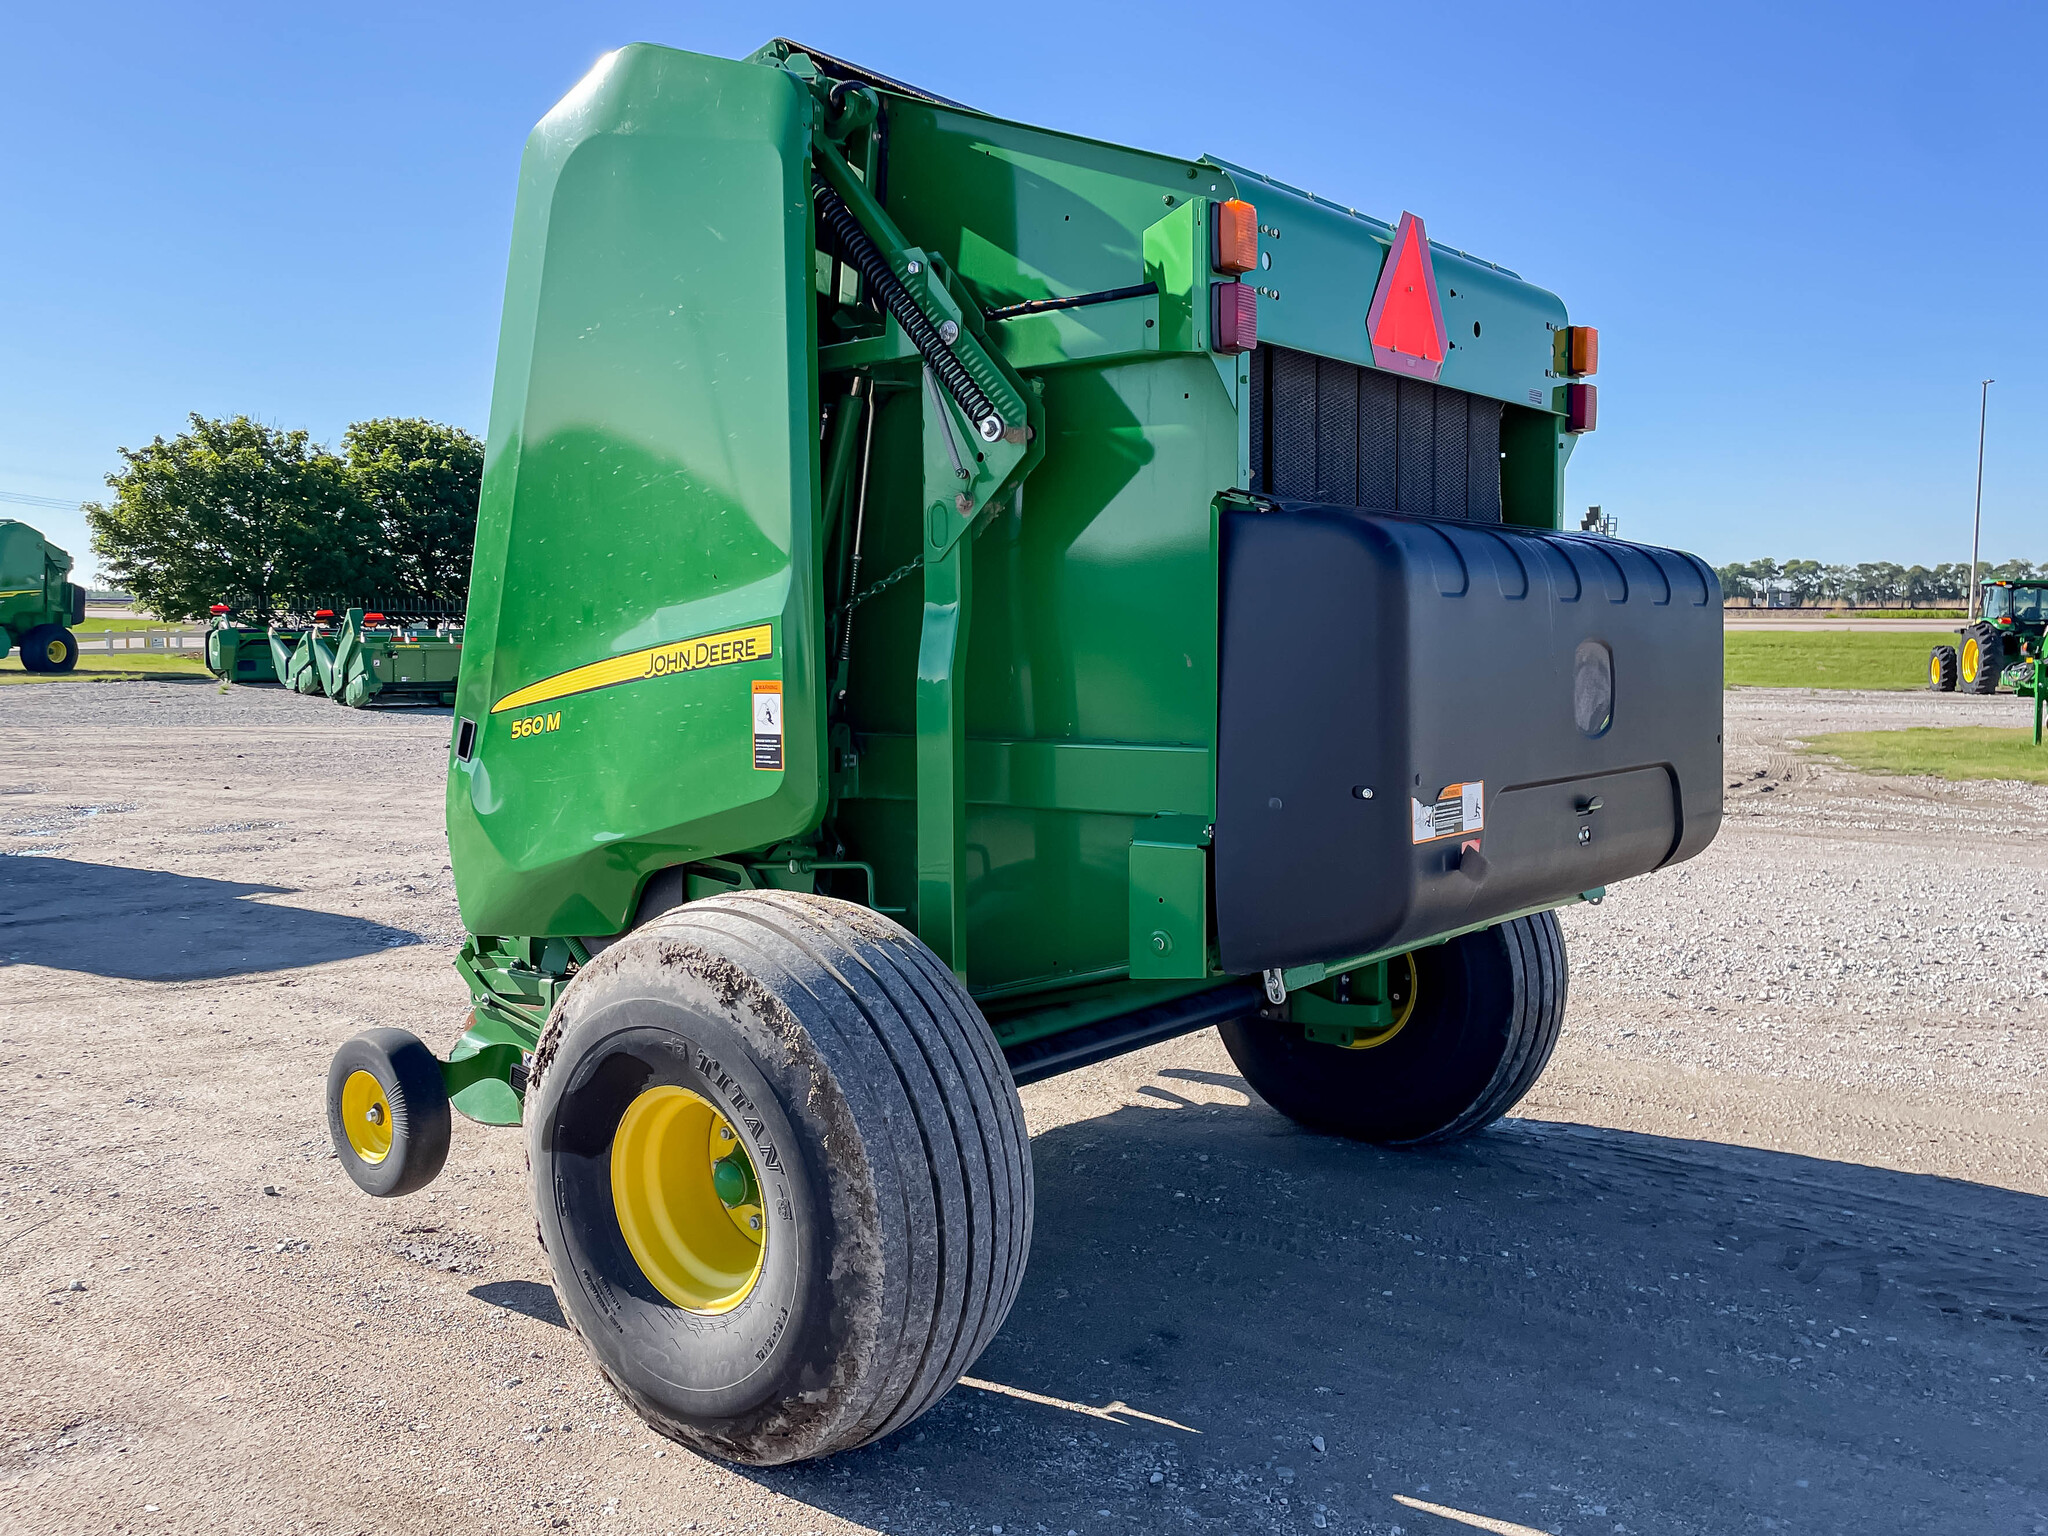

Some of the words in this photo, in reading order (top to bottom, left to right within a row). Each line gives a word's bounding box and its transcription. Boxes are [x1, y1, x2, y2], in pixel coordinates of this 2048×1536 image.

[645, 649, 691, 675] JOHN
[696, 638, 756, 665] DEERE
[511, 714, 545, 740] 560
[546, 710, 562, 733] M
[695, 1047, 786, 1176] TITAN
